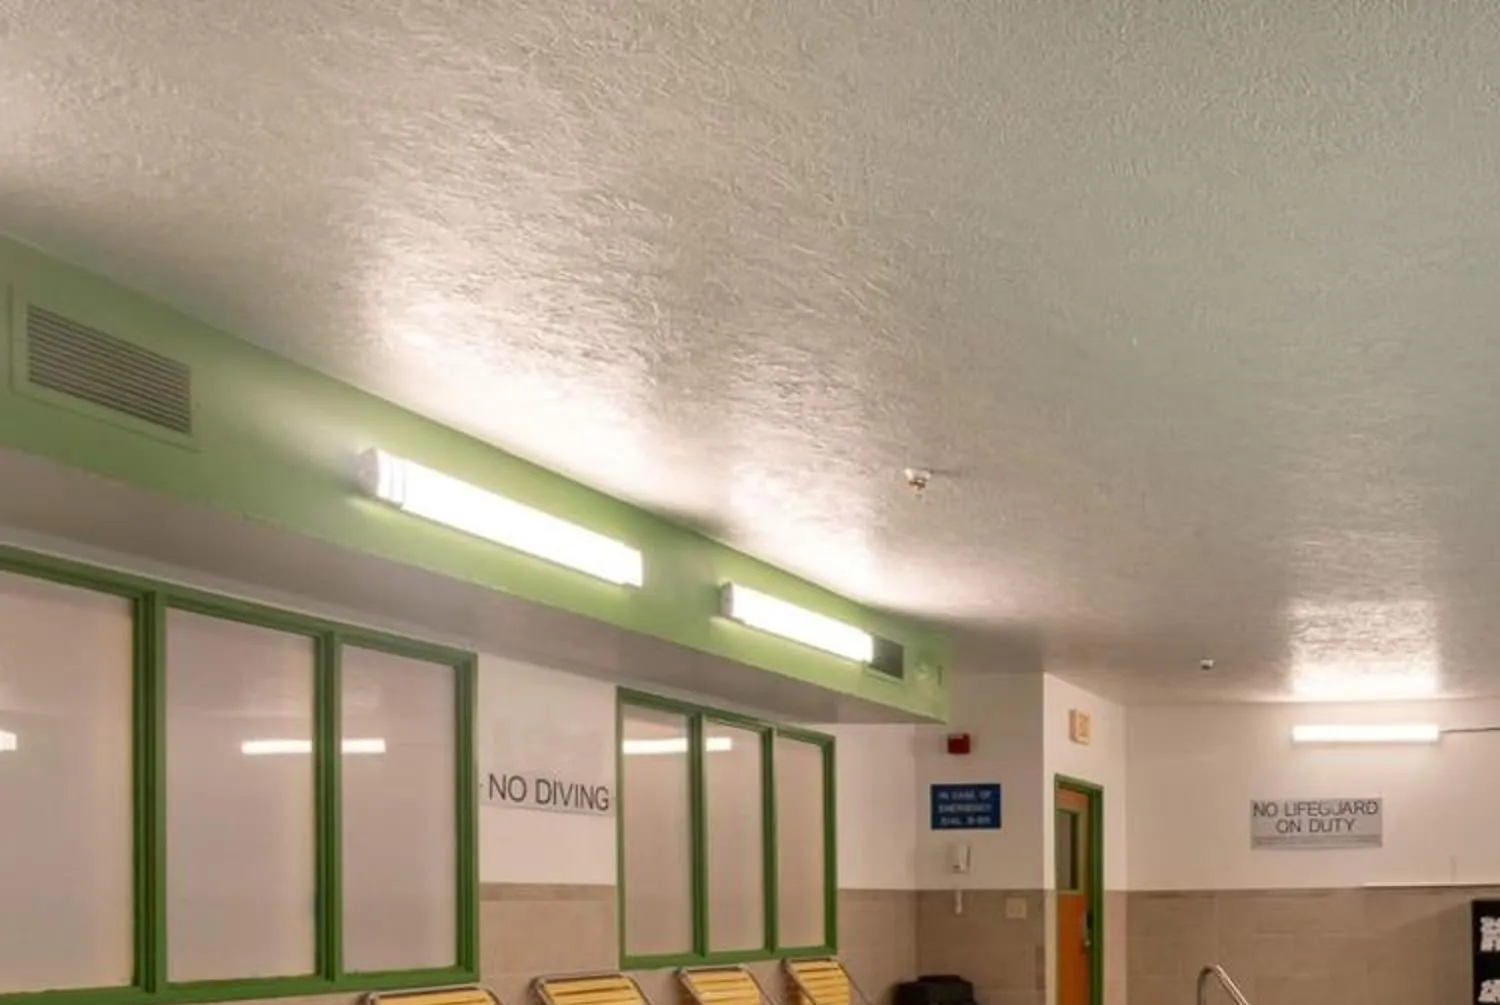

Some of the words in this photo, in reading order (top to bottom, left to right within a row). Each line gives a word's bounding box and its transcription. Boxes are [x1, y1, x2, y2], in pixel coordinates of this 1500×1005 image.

[488, 773, 527, 802] NO
[535, 778, 609, 811] DIVING
[1253, 801, 1278, 817] NO
[1284, 800, 1378, 817] LIFEGUARD
[1276, 819, 1301, 833] ON
[1309, 818, 1357, 833] DUTY
